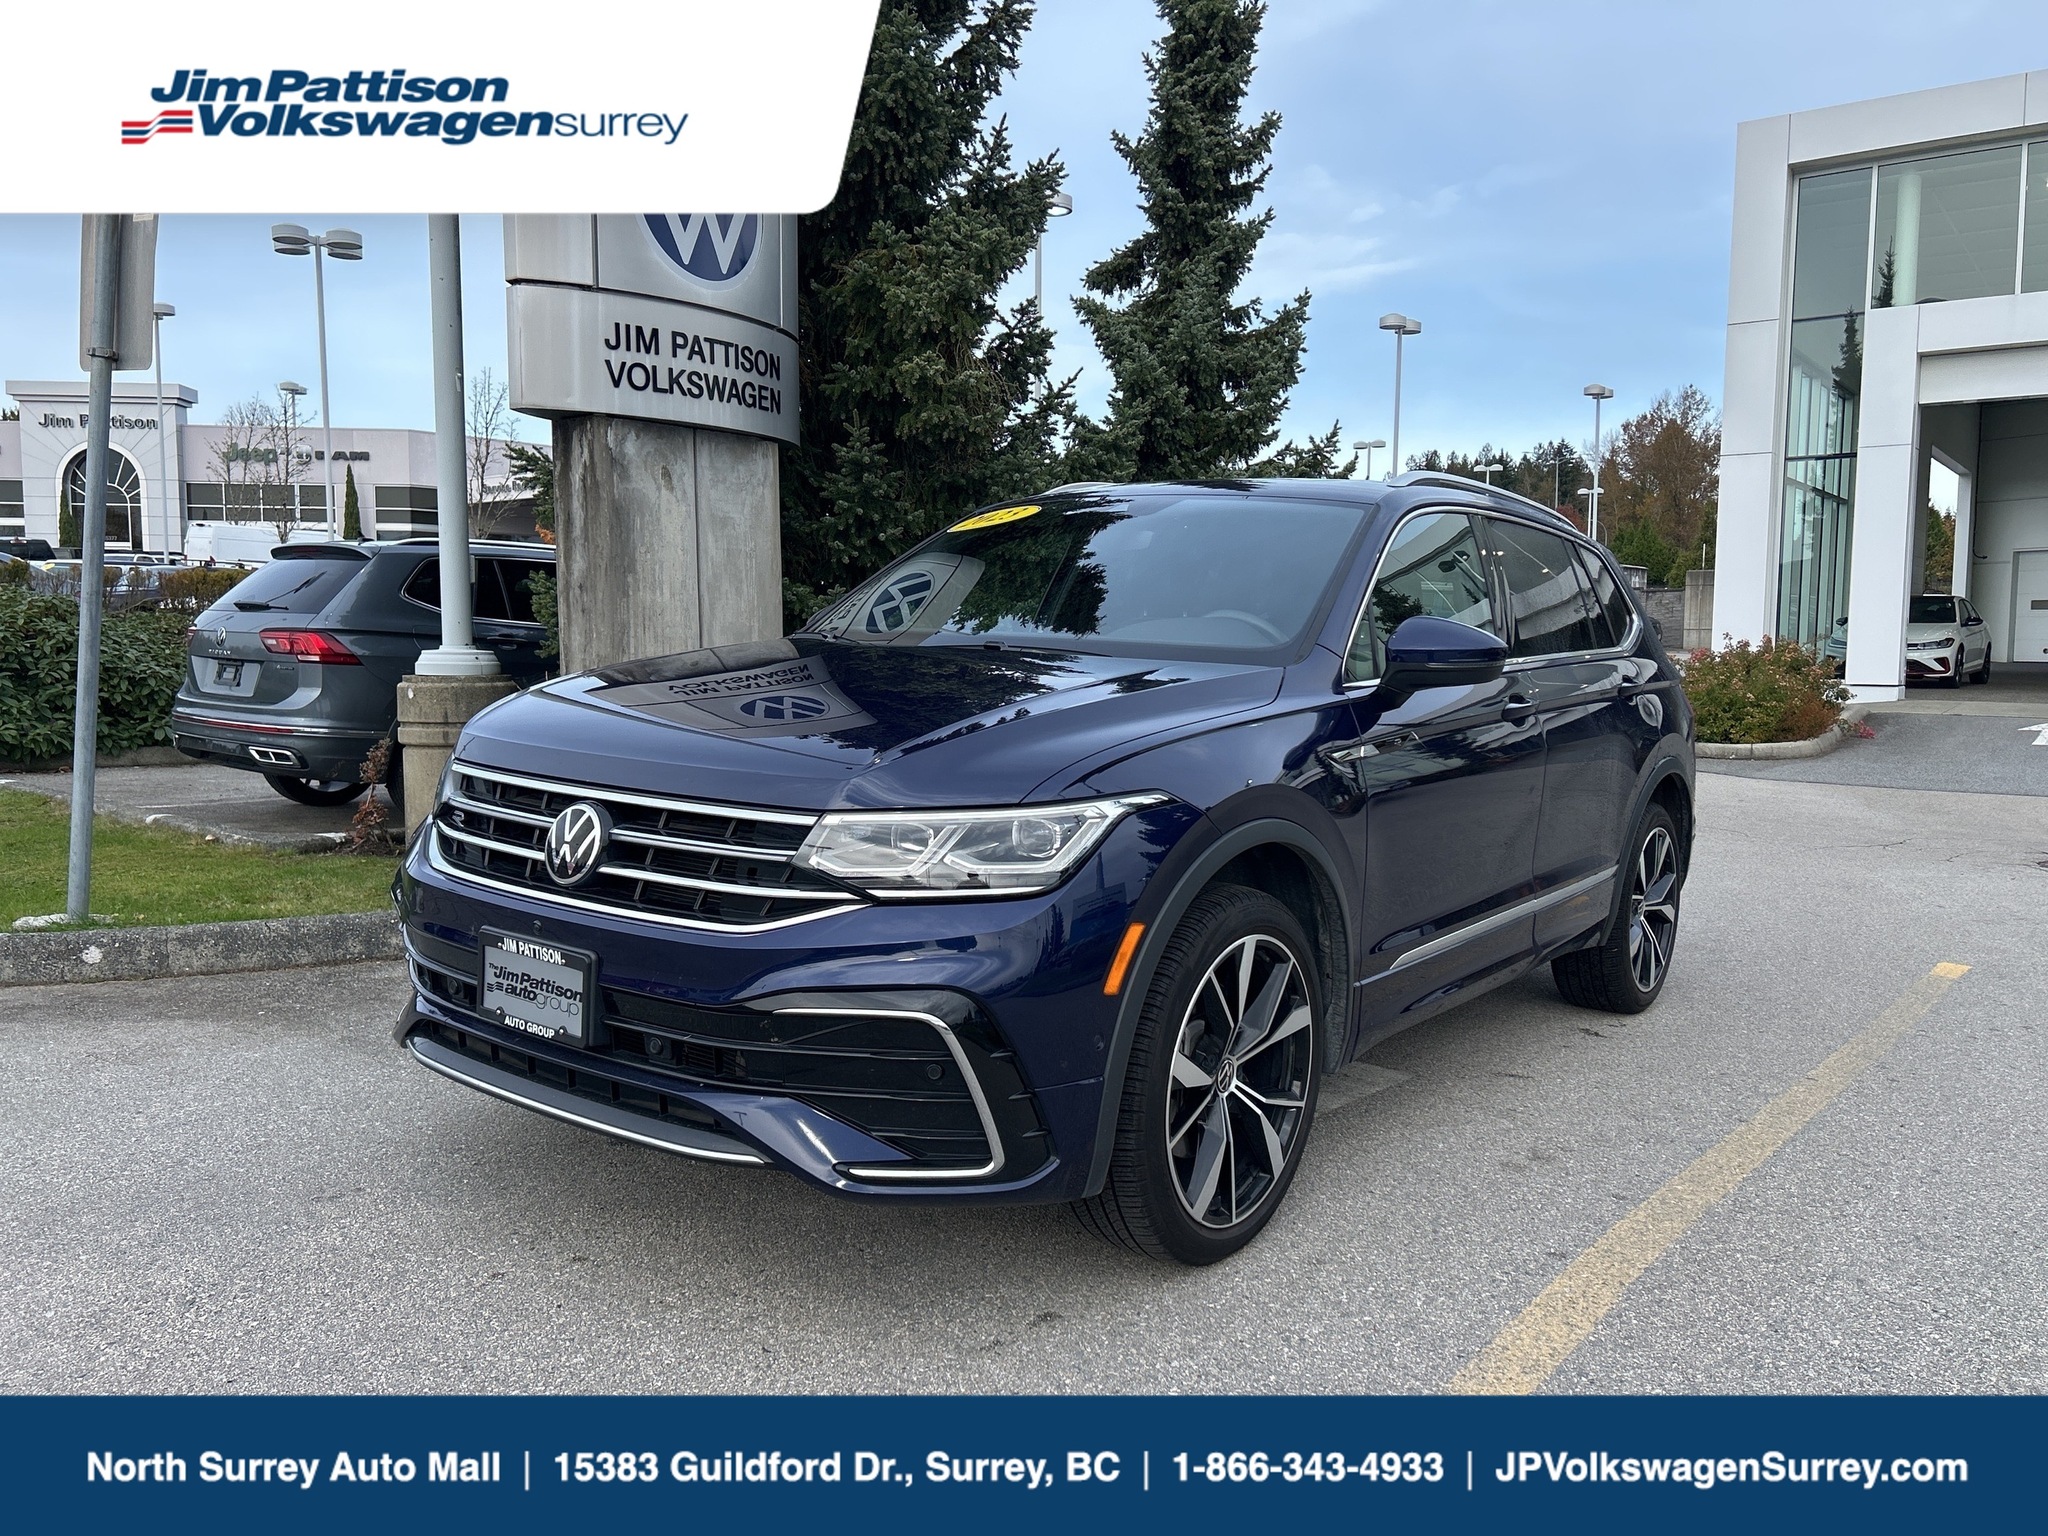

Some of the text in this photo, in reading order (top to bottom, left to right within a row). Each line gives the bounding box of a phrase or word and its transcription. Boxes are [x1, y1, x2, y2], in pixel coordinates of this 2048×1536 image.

[604, 322, 781, 382] JIM PATTISON
[604, 360, 782, 415] VOLKSWAGEN
[38, 413, 158, 430] Jim Ptison
[502, 938, 562, 965] JIM PATTISON
[488, 962, 499, 971] The
[504, 1015, 555, 1039] AUTO GROUP
